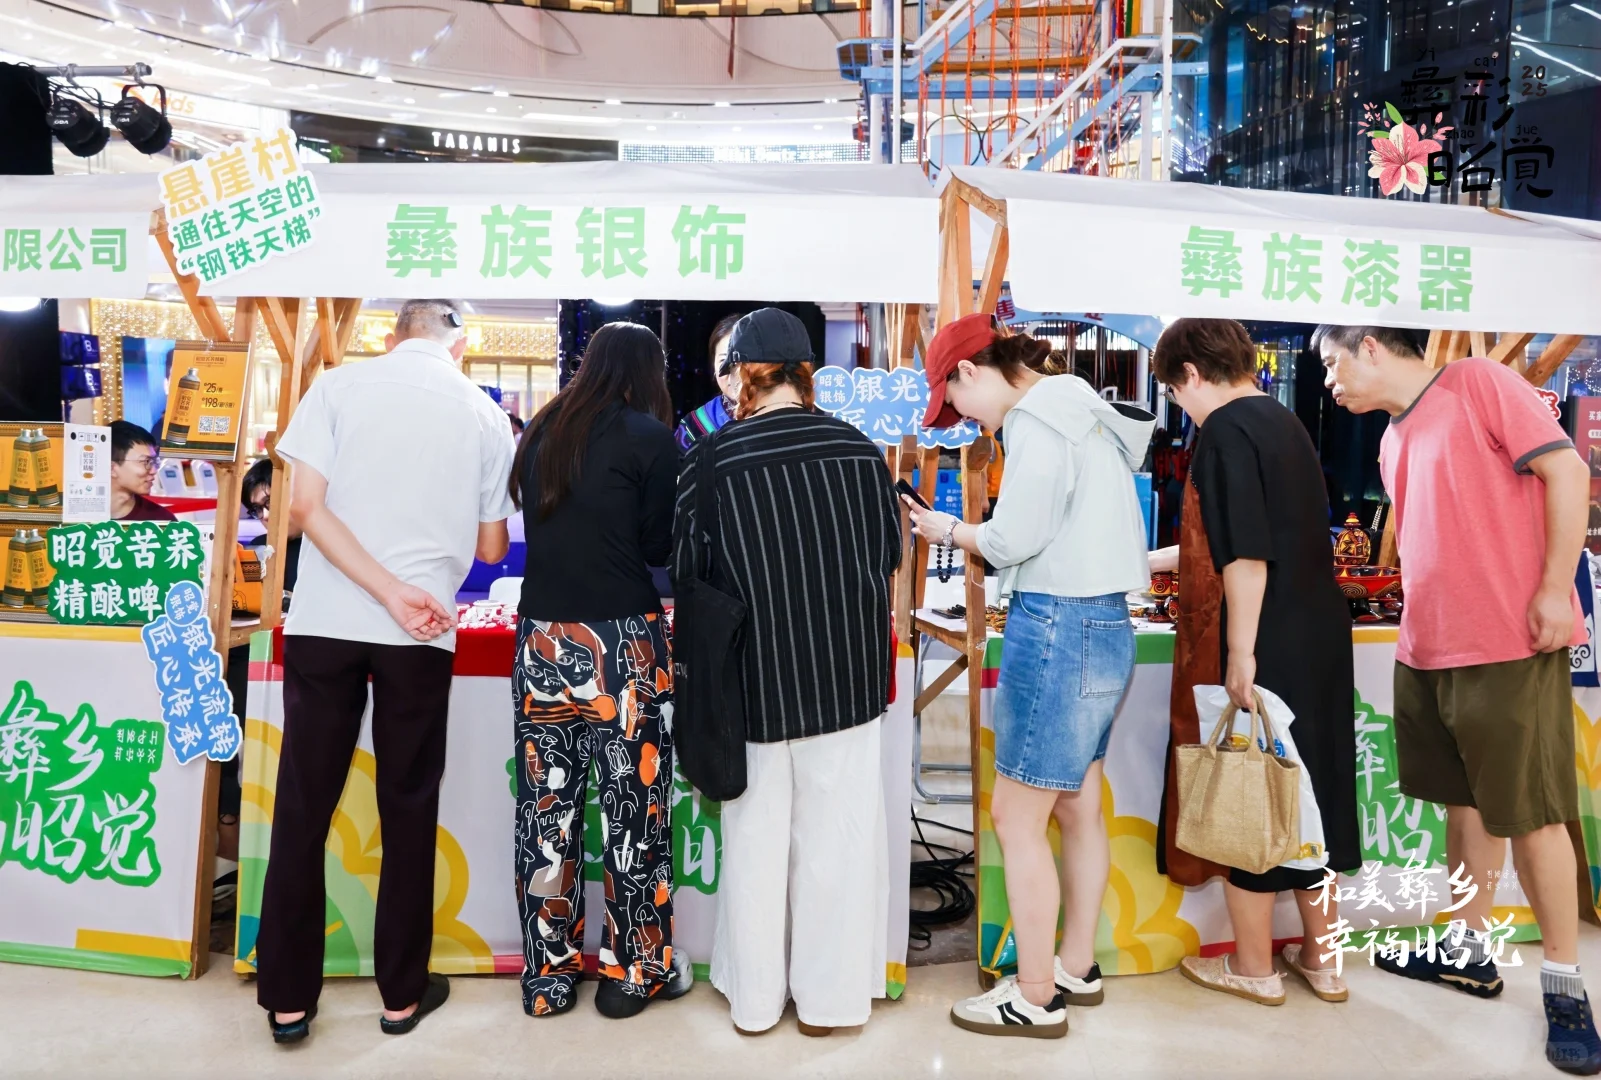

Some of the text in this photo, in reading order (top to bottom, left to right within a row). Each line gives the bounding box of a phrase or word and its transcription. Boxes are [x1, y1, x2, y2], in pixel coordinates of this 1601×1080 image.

[431, 131, 520, 154] TARANIS
[162, 128, 298, 219] 悬崖村
[172, 175, 315, 254] 通往天空的
[3, 227, 126, 272] 限公司
[386, 203, 746, 280] 彝族银饰
[1180, 225, 1474, 312] 彝族漆器
[819, 373, 846, 388] 昭觉
[819, 390, 846, 404] 银饰
[52, 527, 198, 570] 昭觉苦荞
[53, 578, 172, 621] 精酿啤
[170, 594, 186, 620] 银饰
[183, 587, 200, 615] 昭觉
[148, 620, 204, 756] 匠心传承
[180, 621, 235, 756] 银光流转
[0, 789, 153, 877] 昭觉
